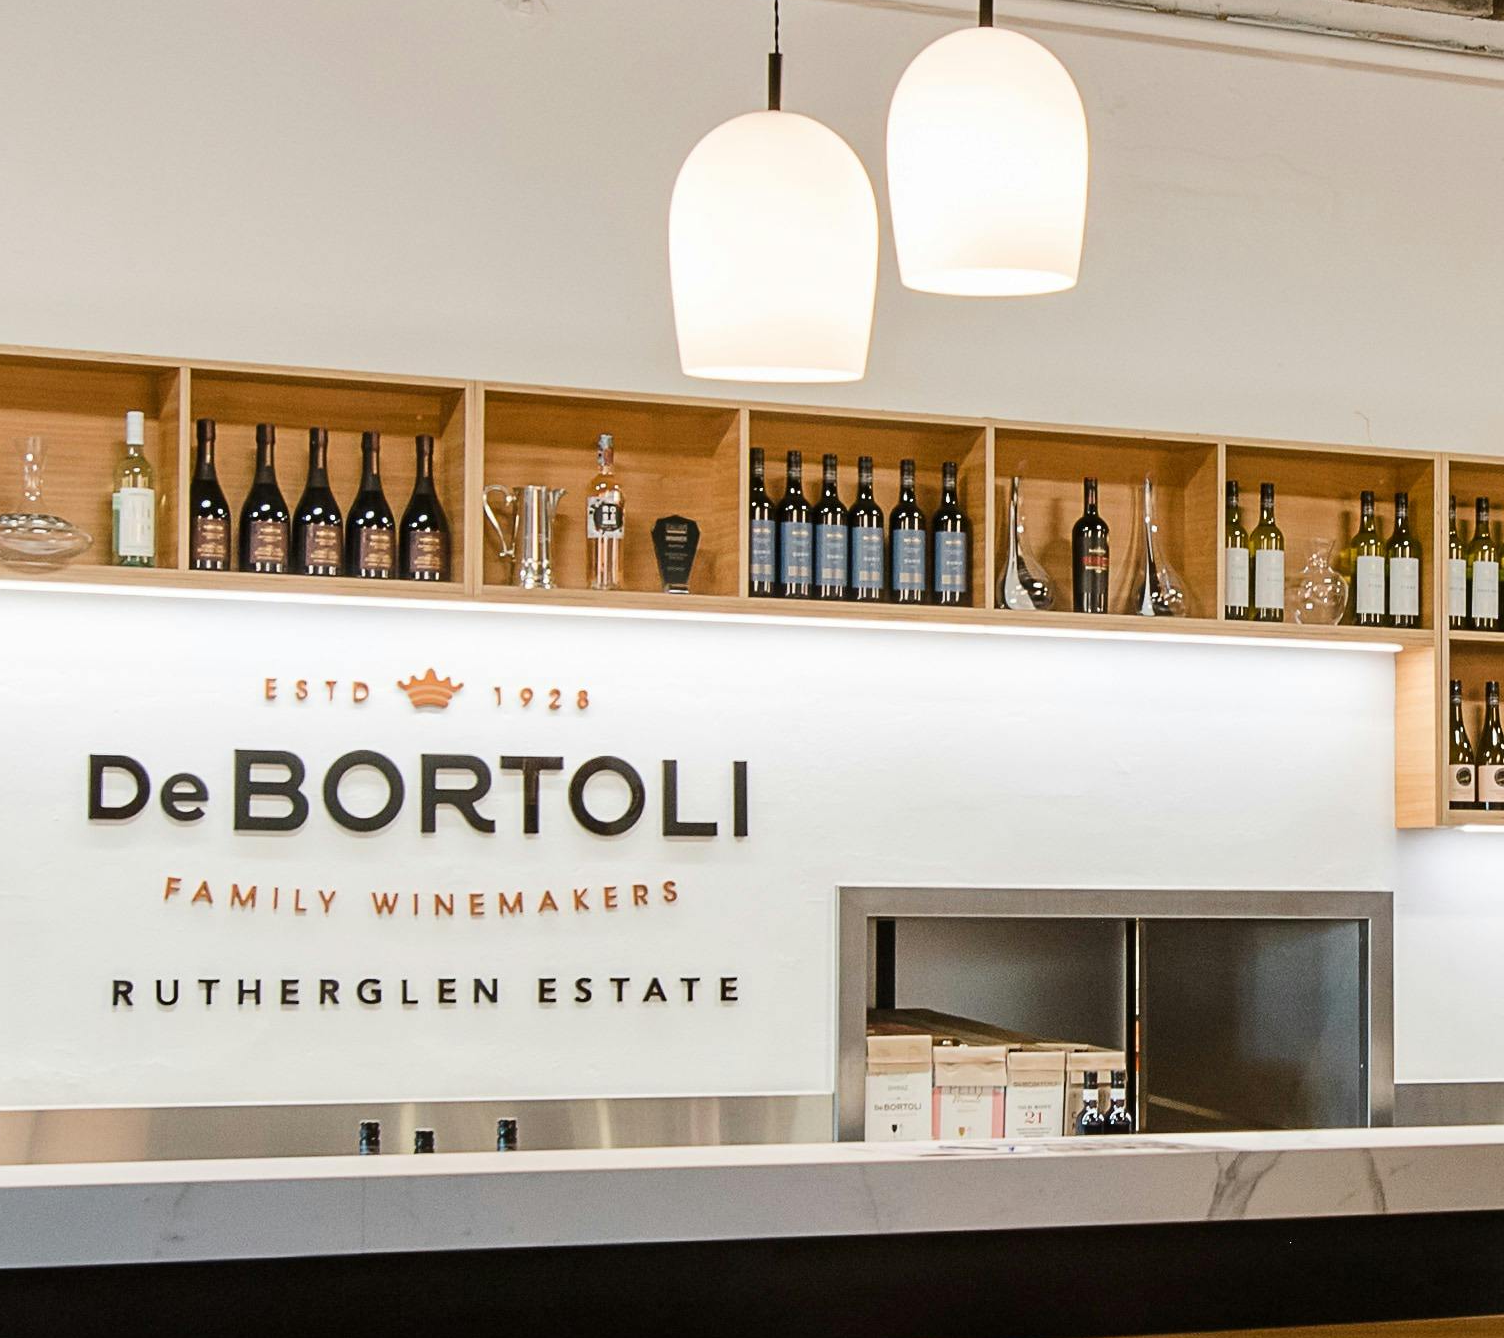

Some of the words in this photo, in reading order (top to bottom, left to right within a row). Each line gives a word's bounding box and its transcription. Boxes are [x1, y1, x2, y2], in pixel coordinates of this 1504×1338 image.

[264, 677, 370, 705] ESTD
[493, 686, 593, 711] 1928
[163, 875, 339, 916] FAMILY
[371, 880, 682, 918] WINEMAKERS
[111, 977, 500, 1008] RUTHERGLEN
[537, 976, 741, 1005] ESTATE
